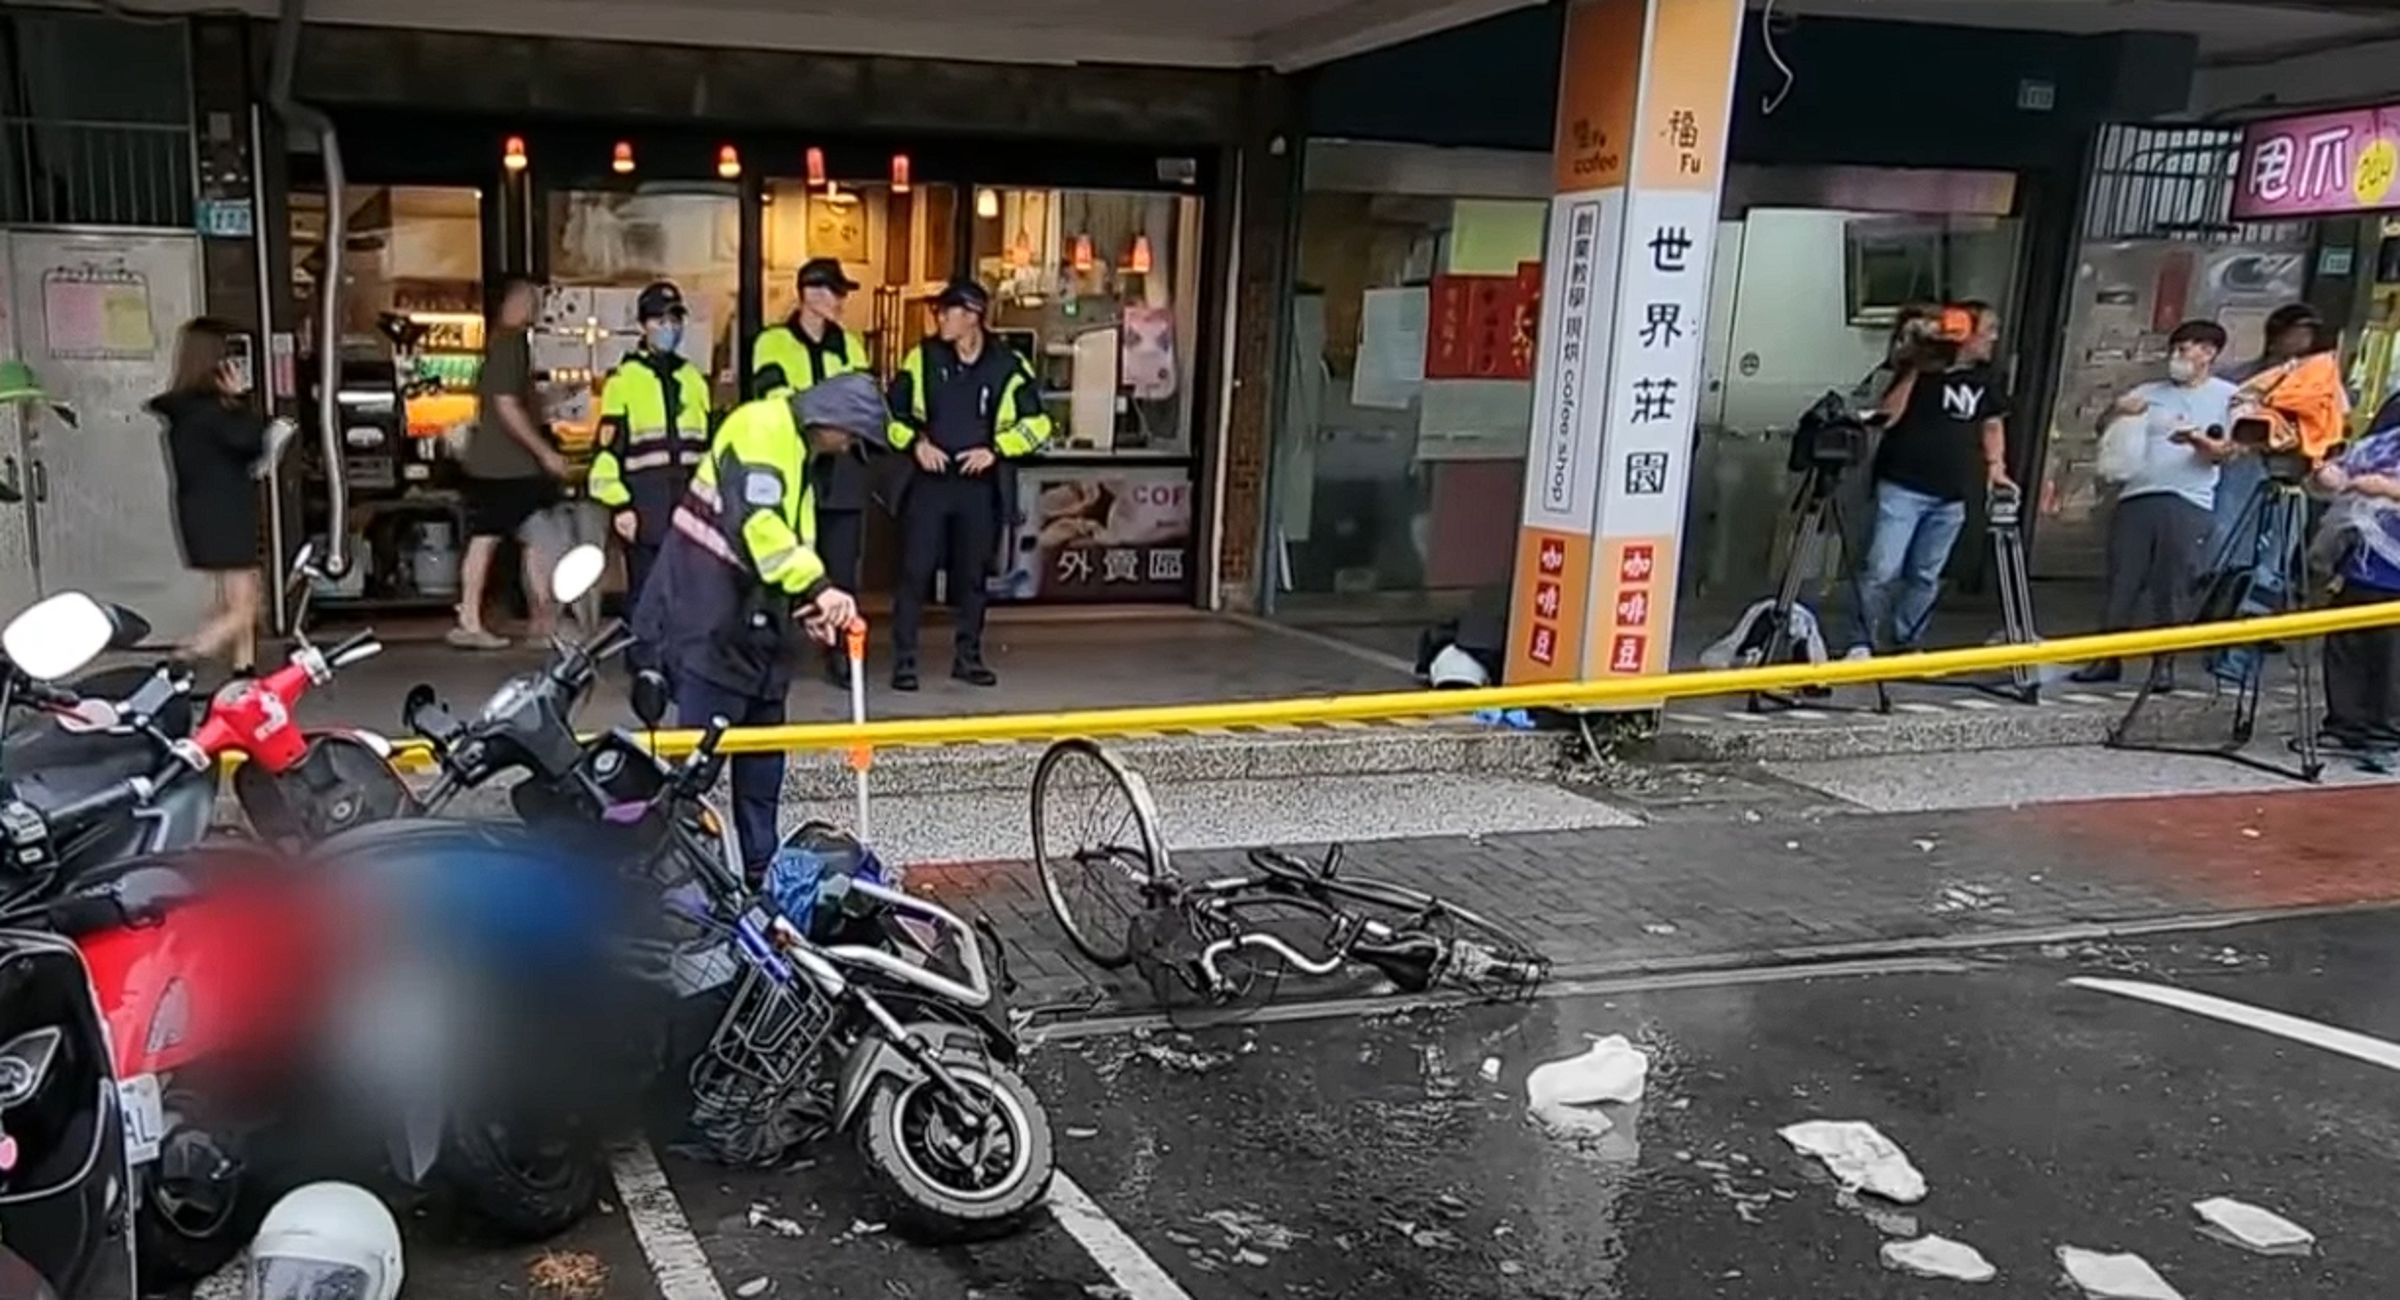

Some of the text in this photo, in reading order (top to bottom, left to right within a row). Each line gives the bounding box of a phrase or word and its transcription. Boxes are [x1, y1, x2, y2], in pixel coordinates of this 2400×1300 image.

[1668, 110, 1699, 148] 福
[1680, 153, 1701, 174] Fu
[1624, 226, 1693, 495] 世界莊園
[1943, 384, 1986, 416] NY
[1551, 442, 1568, 502] shop
[1057, 549, 1184, 582] 外賣區
[1532, 544, 1563, 662] 咖啡豆
[1613, 550, 1652, 669] 咖啡豆
